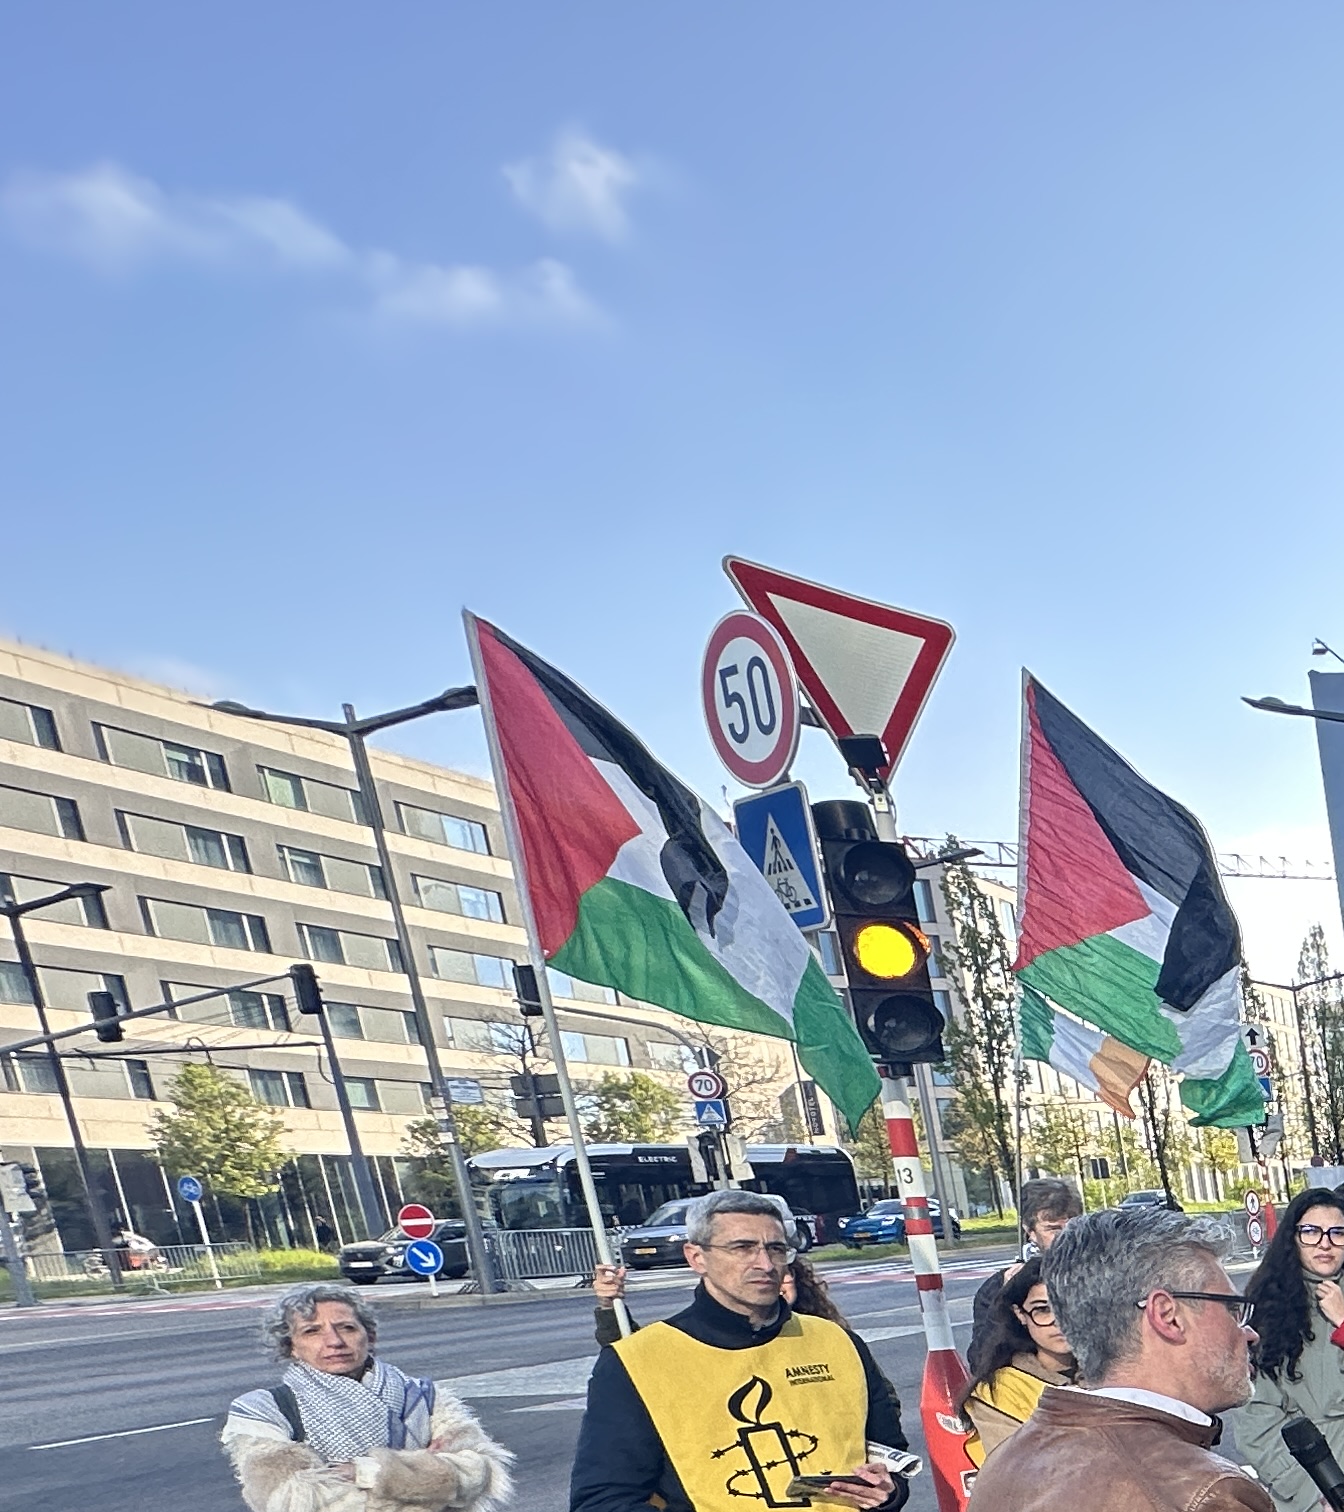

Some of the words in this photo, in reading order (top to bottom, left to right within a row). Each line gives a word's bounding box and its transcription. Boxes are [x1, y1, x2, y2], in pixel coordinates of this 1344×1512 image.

[719, 655, 776, 744] 50
[695, 1079, 713, 1092] 70
[785, 1363, 830, 1379] AMNESTY
